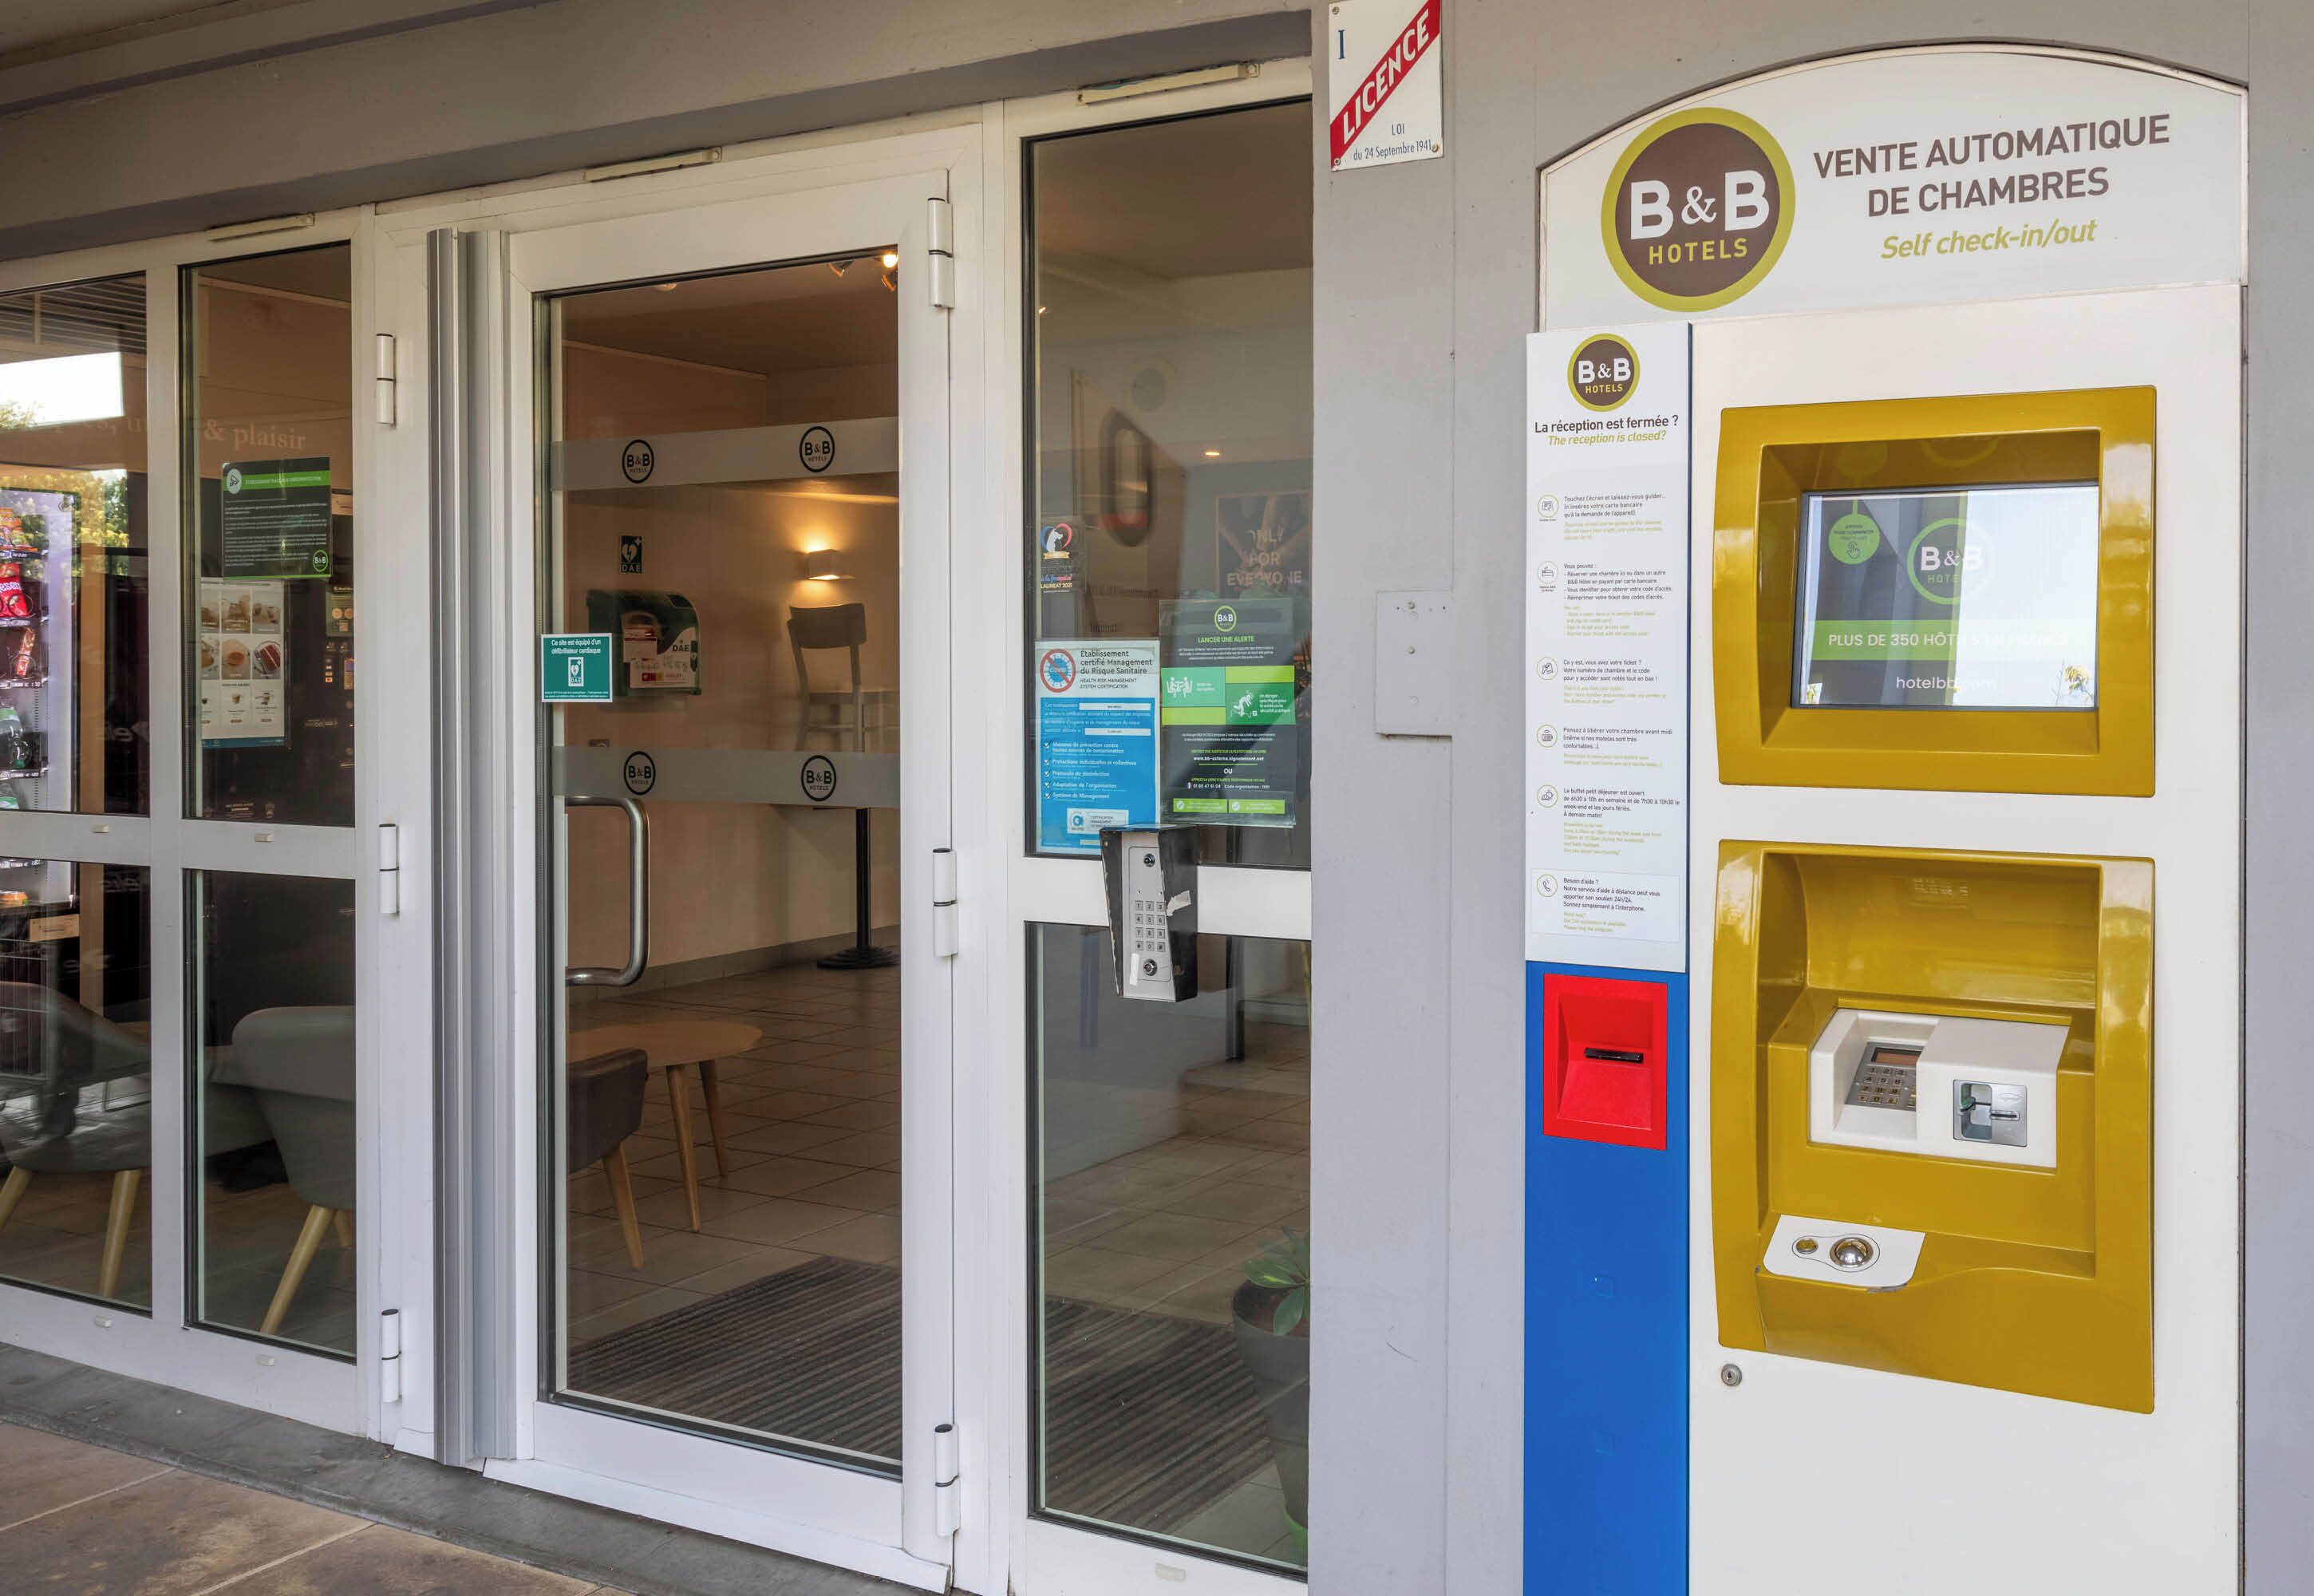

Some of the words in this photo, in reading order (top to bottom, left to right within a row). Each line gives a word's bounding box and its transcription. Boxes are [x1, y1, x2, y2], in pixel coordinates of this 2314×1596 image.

[1343, 9, 1429, 144] LICENCE
[1392, 124, 1404, 135] LOI
[1353, 148, 1362, 160] du
[1364, 148, 1373, 159] 24
[1376, 141, 1414, 159] Septembre
[1416, 140, 1431, 152] 1941
[1814, 142, 1918, 179] VENTE
[1926, 114, 2170, 169] AUTOMATIQUE
[1868, 187, 1909, 216] DE
[1919, 168, 2109, 212] CHAMBRES
[1631, 170, 1770, 239] B&B
[1882, 228, 1929, 259] Self
[1937, 219, 2098, 255] check-in/out
[1649, 238, 1747, 265] HOTELS
[1578, 358, 1631, 383] B&B
[1585, 384, 1623, 393] HOTELS
[1535, 422, 1548, 433] La
[1552, 420, 1603, 433] réception
[1606, 418, 1624, 429] est
[1627, 415, 1668, 429] fermée
[233, 422, 306, 449] plaisir
[1548, 435, 1566, 445] The
[1569, 433, 1615, 445] reception
[1617, 432, 1625, 442] is
[1627, 430, 1666, 441] closed?
[805, 440, 830, 456] B&B
[1828, 634, 1863, 646] PLUS
[1867, 634, 1886, 646] DE
[1890, 634, 1919, 646] 350
[807, 770, 831, 784] B&B
